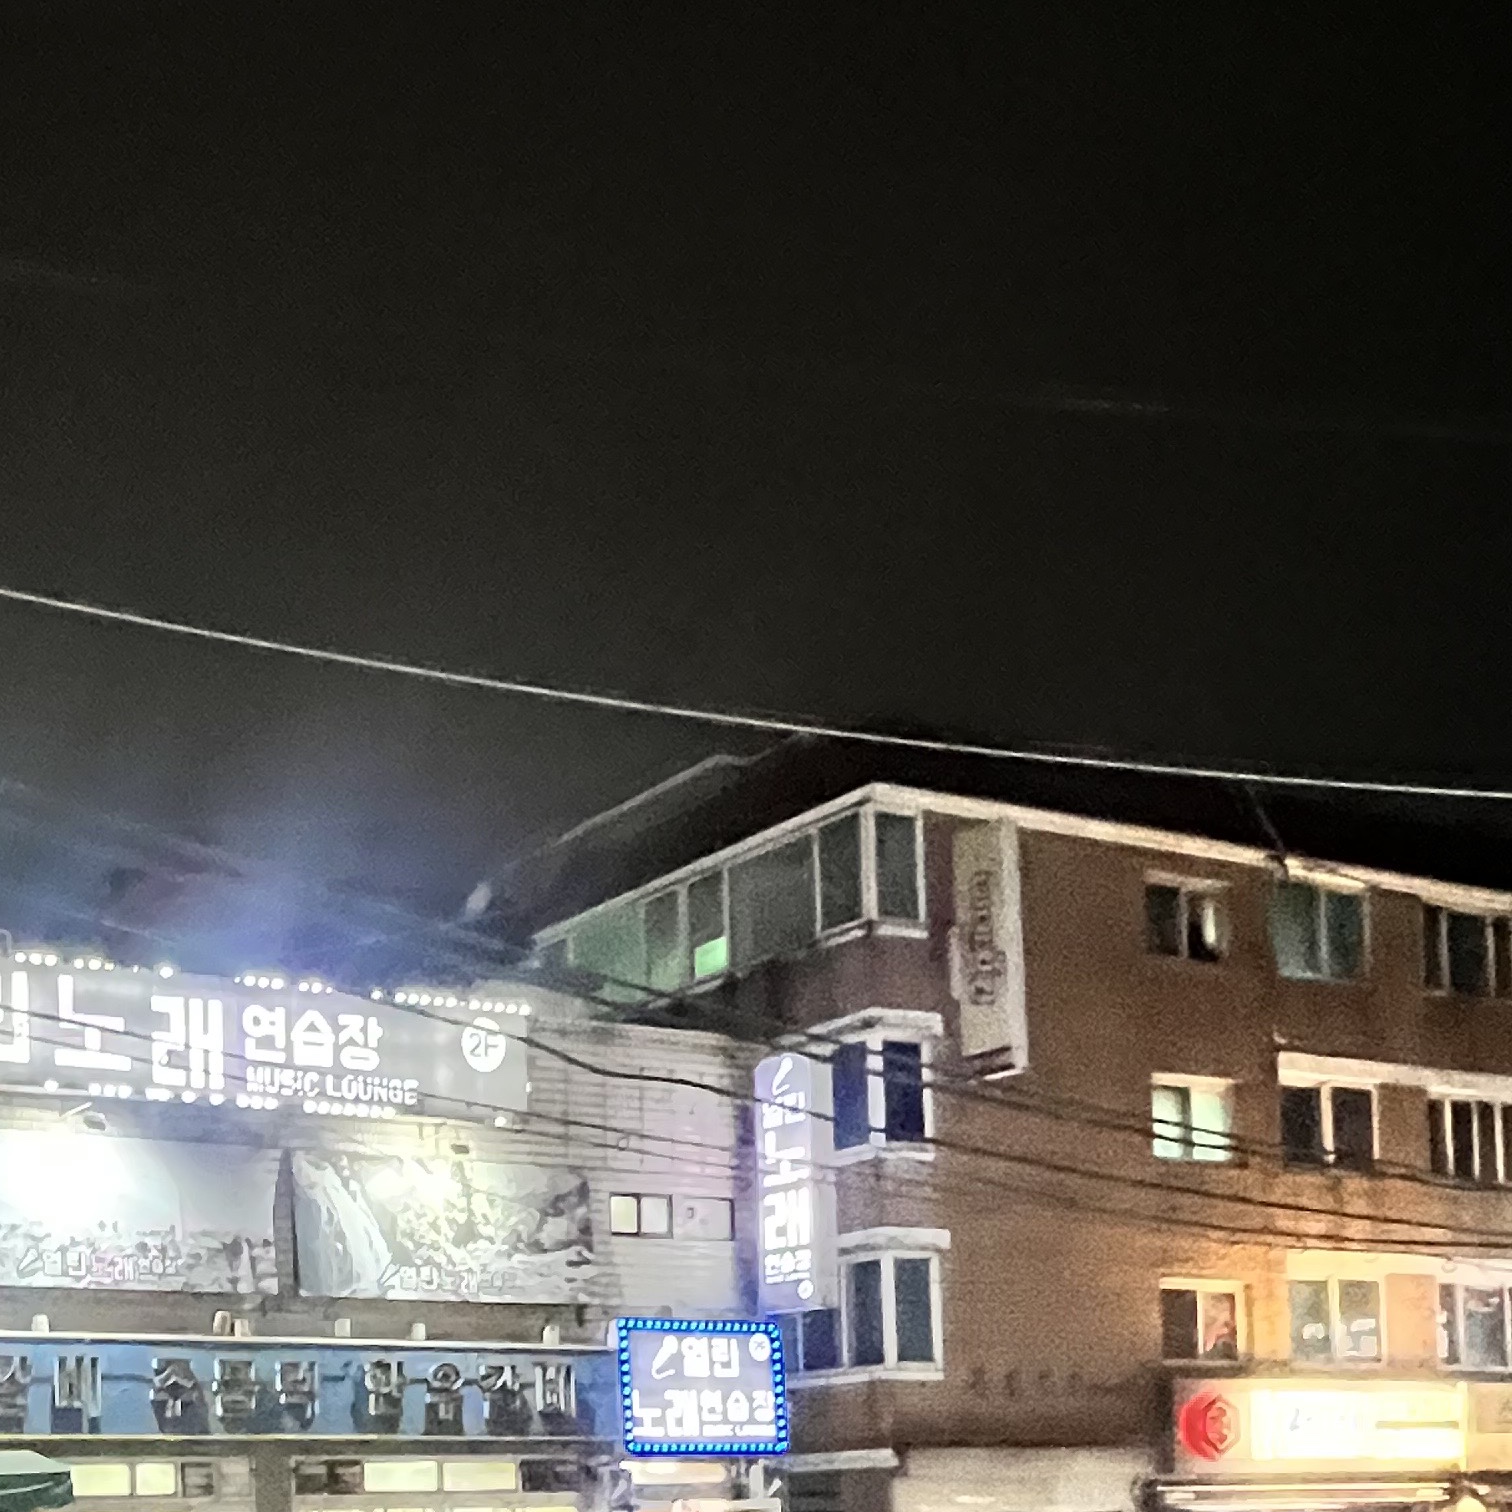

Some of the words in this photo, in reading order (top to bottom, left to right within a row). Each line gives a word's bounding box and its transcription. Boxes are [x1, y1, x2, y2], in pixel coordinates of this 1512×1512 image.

[243, 1004, 384, 1071] 연습장
[246, 1066, 320, 1097] MUSIC
[325, 1074, 419, 1105] LOUNGE
